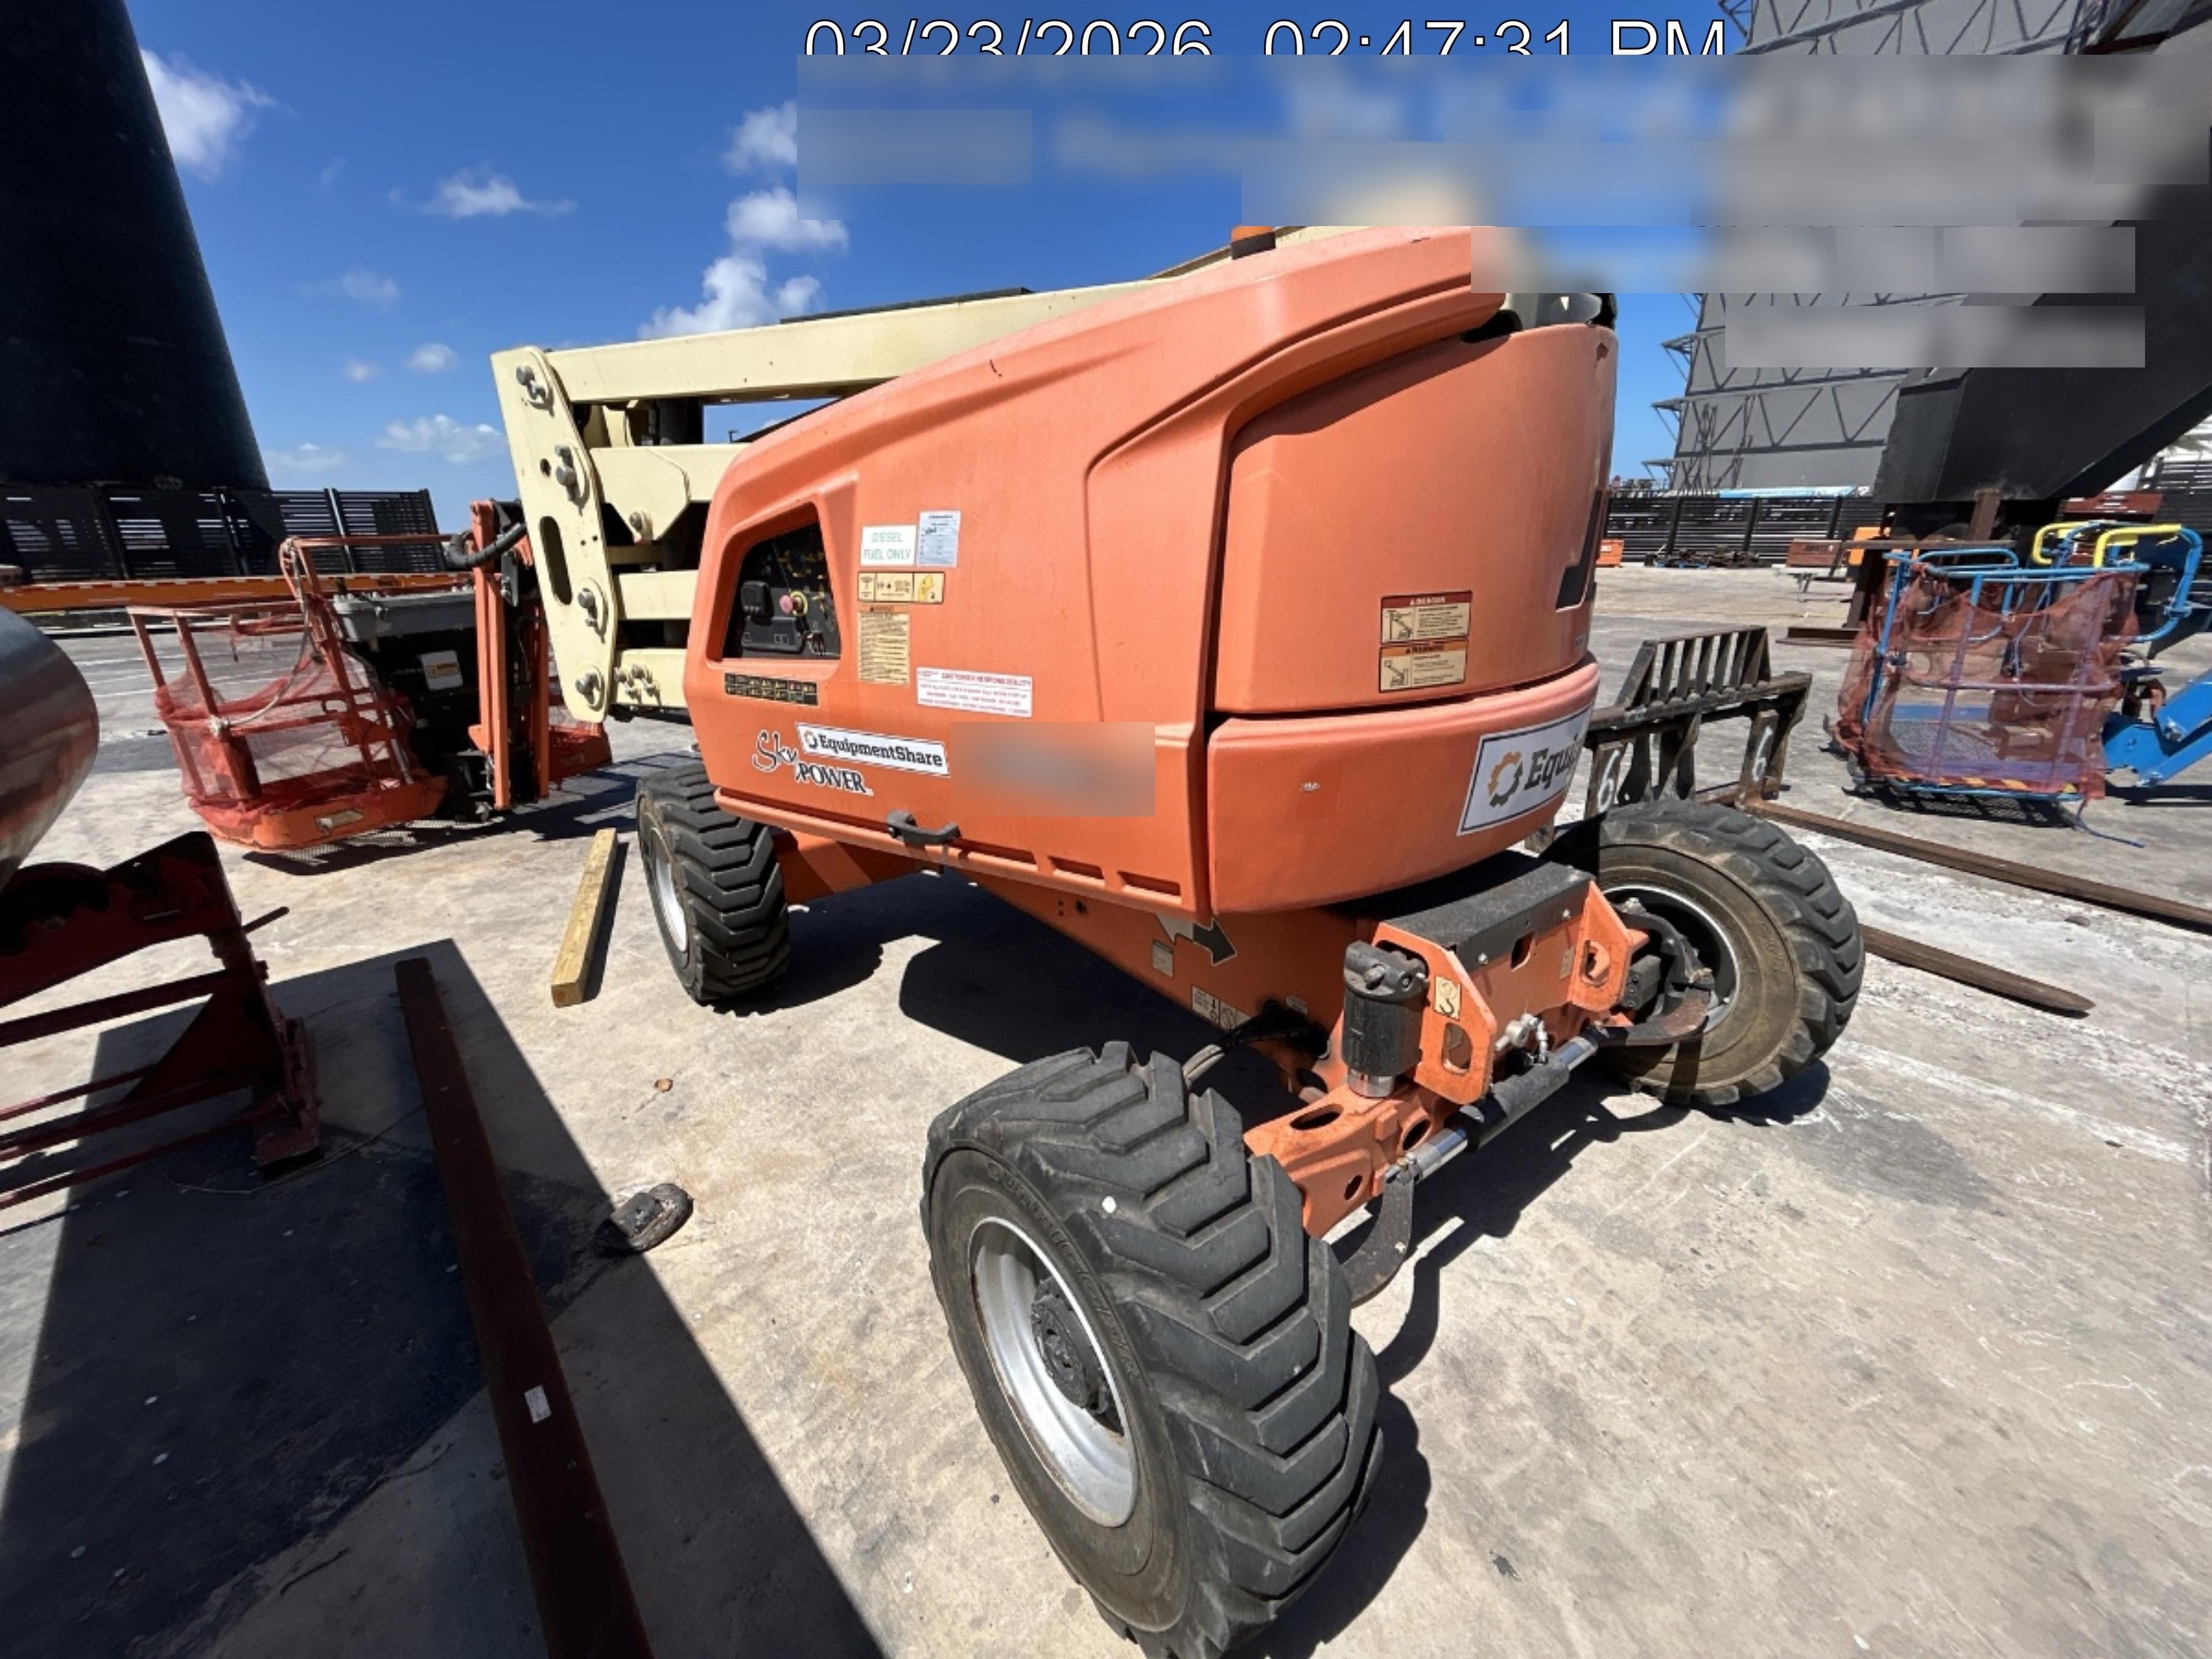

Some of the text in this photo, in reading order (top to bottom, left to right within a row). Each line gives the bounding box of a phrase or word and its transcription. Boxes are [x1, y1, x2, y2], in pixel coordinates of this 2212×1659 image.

[871, 532, 903, 543] DIESEL
[864, 549, 911, 560] FUEL ONLY
[818, 735, 943, 767] EquipmentShare
[797, 762, 867, 793] POWER
